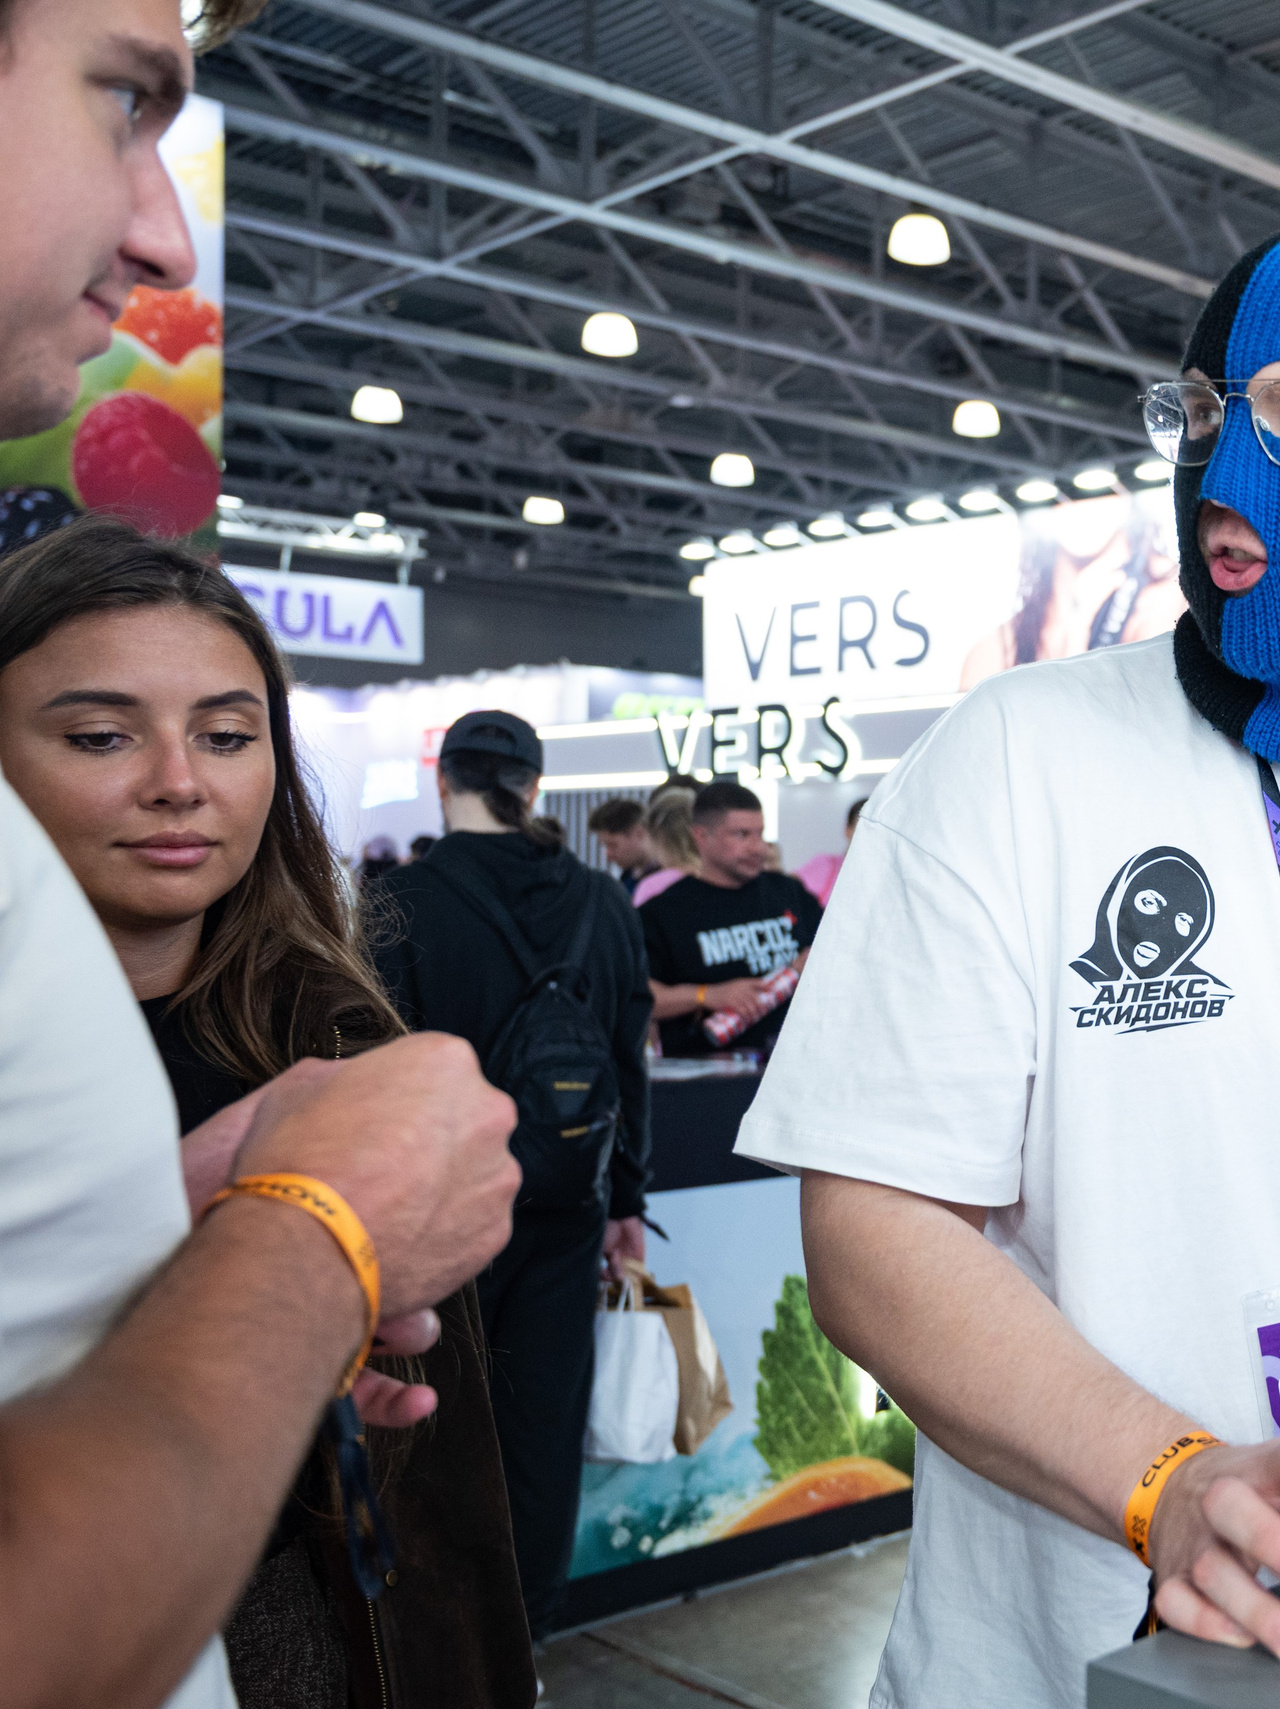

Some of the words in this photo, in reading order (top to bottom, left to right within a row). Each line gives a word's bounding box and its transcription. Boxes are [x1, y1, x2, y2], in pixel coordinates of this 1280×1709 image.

[237, 584, 405, 648] ULA
[735, 589, 930, 681] VERS
[655, 697, 862, 779] VERS
[1076, 999, 1226, 1028] СКИДОНОВ
[1092, 979, 1209, 1005] АЛЕКС
[1142, 1437, 1195, 1488] CLUB
